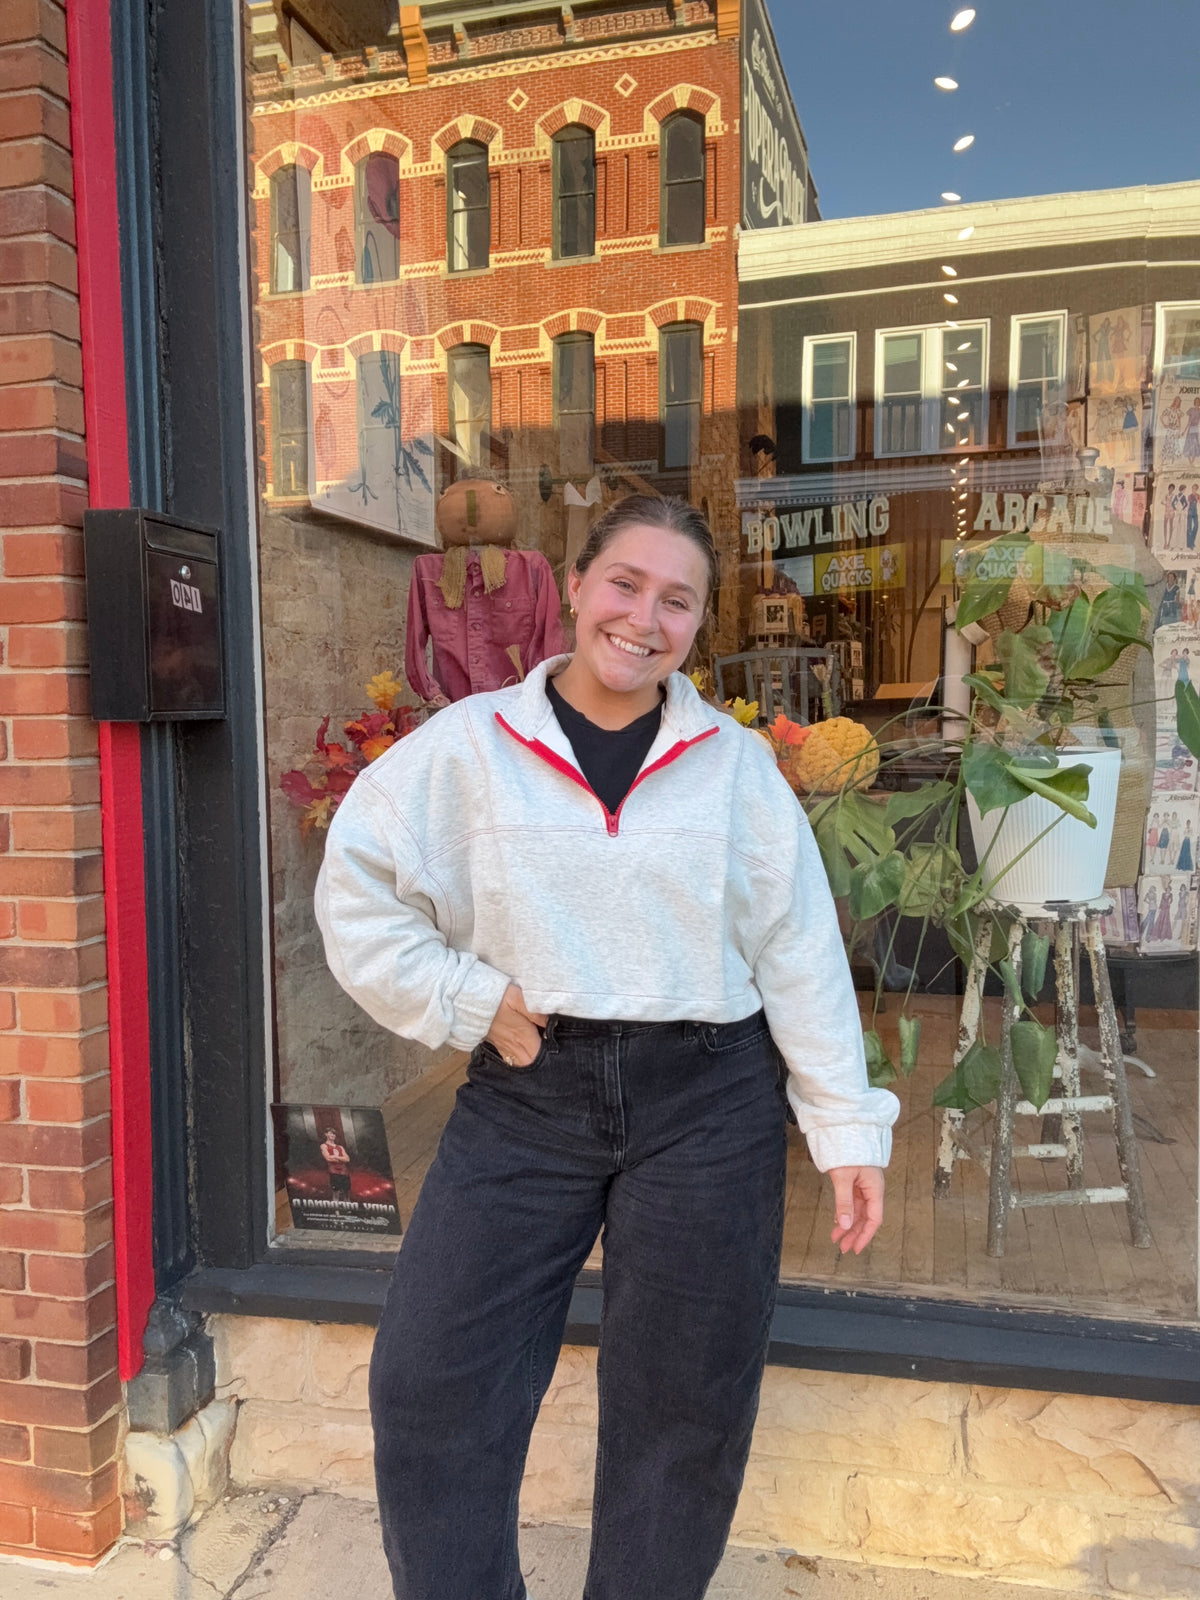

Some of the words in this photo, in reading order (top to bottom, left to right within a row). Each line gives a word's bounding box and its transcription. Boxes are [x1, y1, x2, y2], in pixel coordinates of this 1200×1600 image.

[973, 492, 1113, 534] ARCADE
[746, 496, 890, 554] BOWLING
[827, 554, 865, 572] AXE
[982, 546, 1027, 561] AXE
[822, 568, 872, 593] QUACKS
[976, 561, 1033, 581] QUACKS
